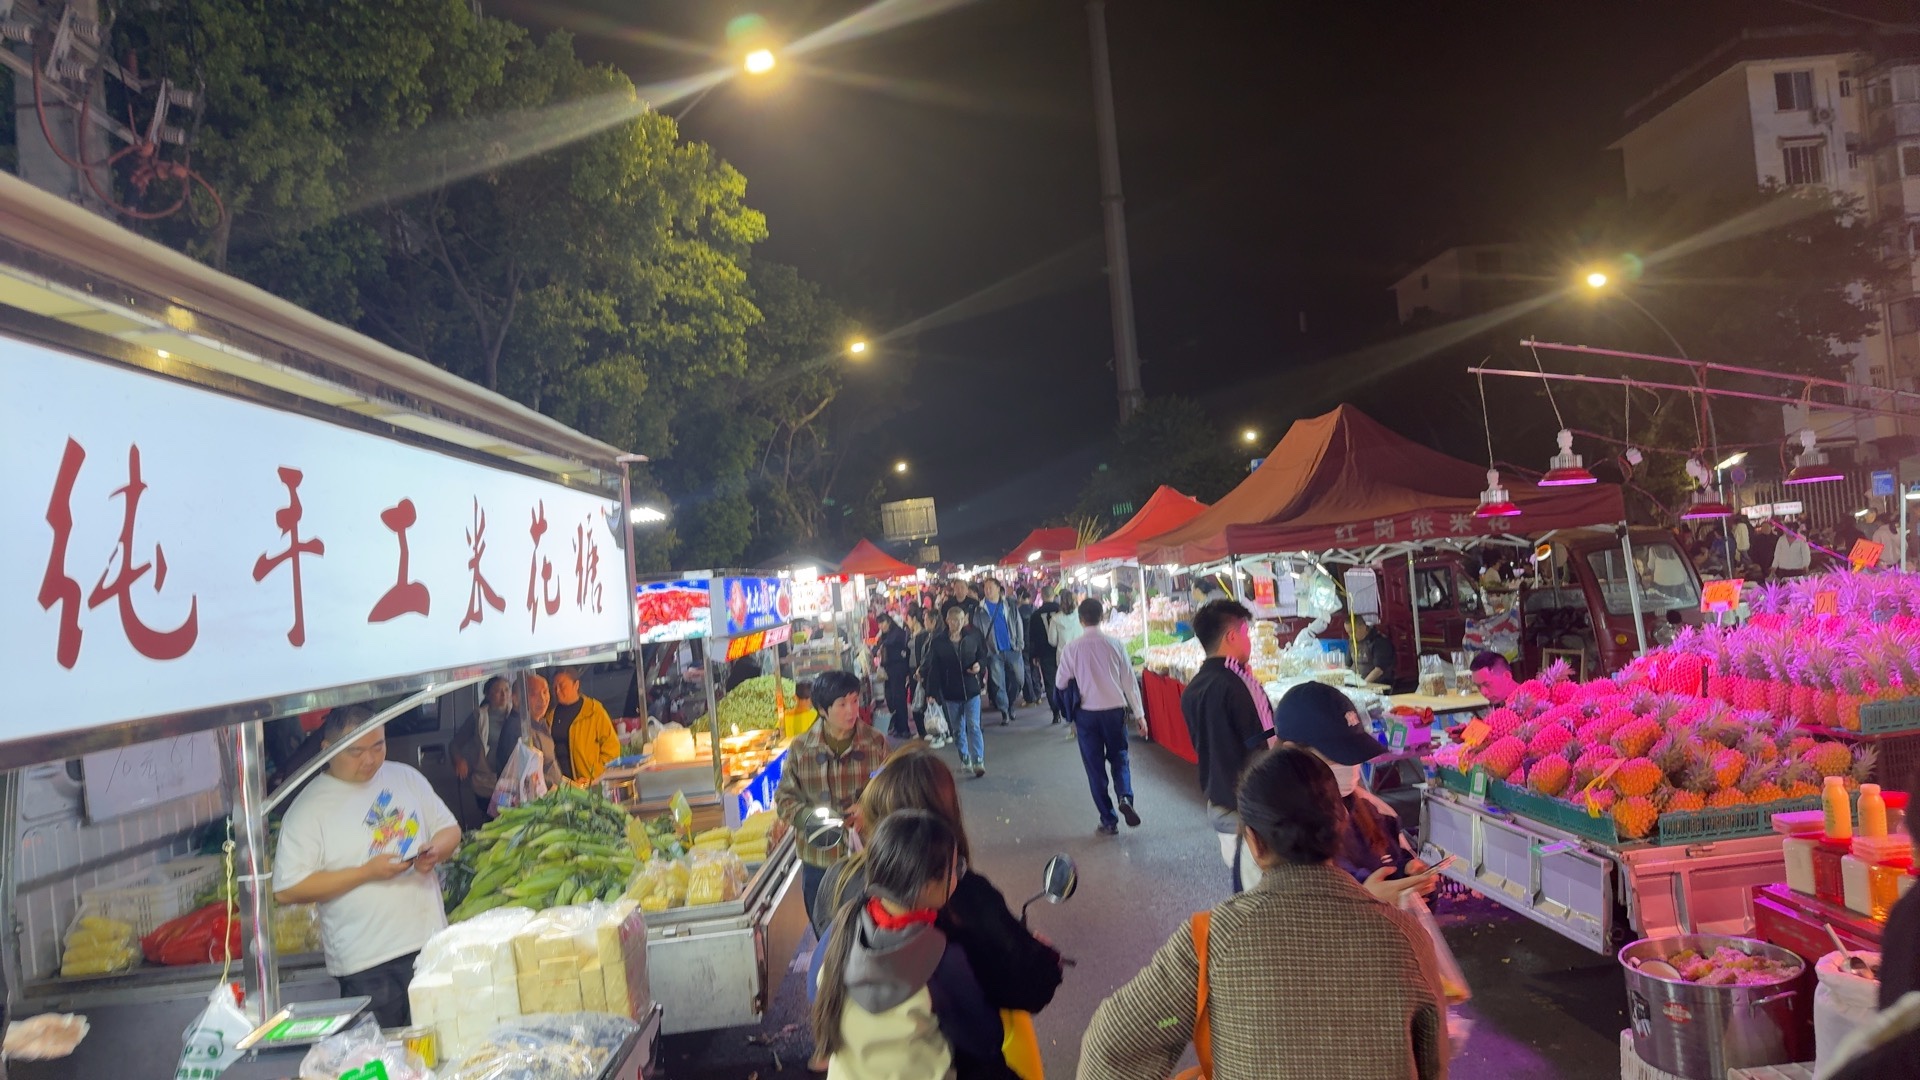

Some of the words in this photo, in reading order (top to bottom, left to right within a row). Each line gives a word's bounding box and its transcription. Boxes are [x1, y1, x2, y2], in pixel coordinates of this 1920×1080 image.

[37, 434, 603, 671] 纯手工米花糖
